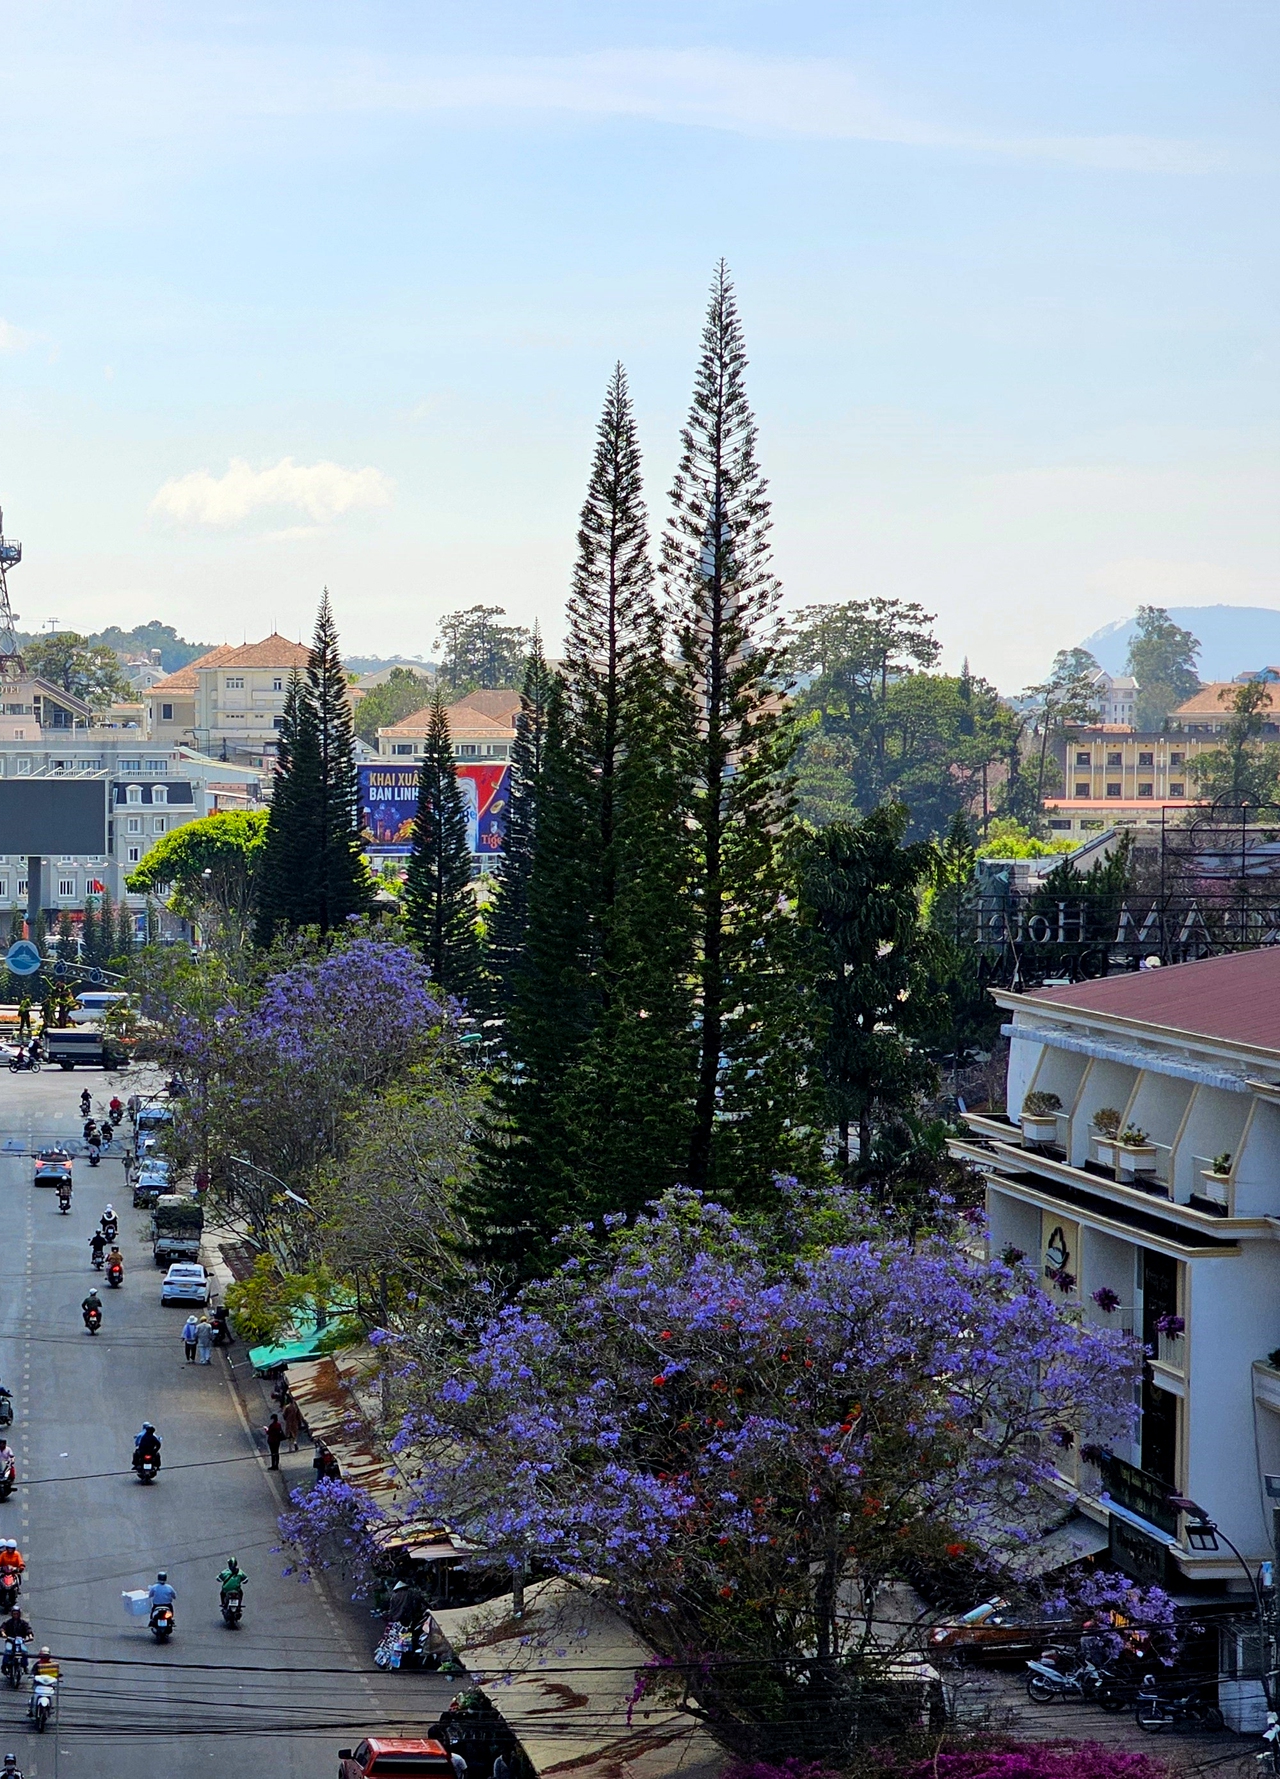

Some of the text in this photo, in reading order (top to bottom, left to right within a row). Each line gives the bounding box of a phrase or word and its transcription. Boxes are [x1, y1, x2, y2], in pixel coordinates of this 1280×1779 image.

[369, 770, 420, 786] KHAI XUÂ
[481, 833, 503, 849] Tige
